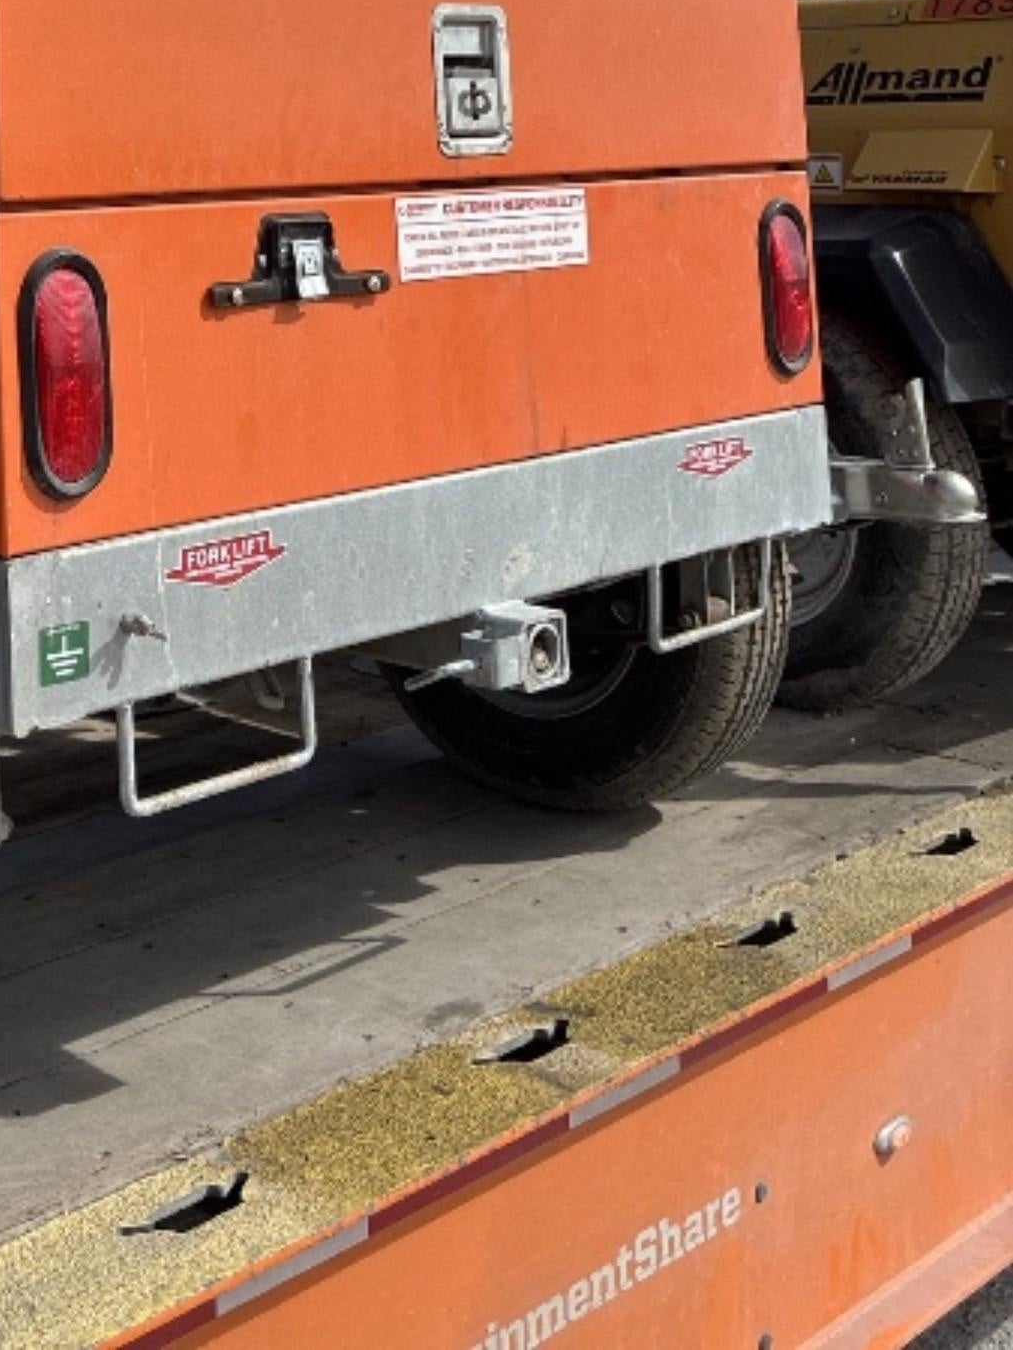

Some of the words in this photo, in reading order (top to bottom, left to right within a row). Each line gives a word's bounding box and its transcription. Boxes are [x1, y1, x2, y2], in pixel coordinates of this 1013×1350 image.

[809, 56, 994, 105] Allmand
[186, 536, 267, 571] FORKLIFT
[470, 1185, 742, 1350] ipmentShare
